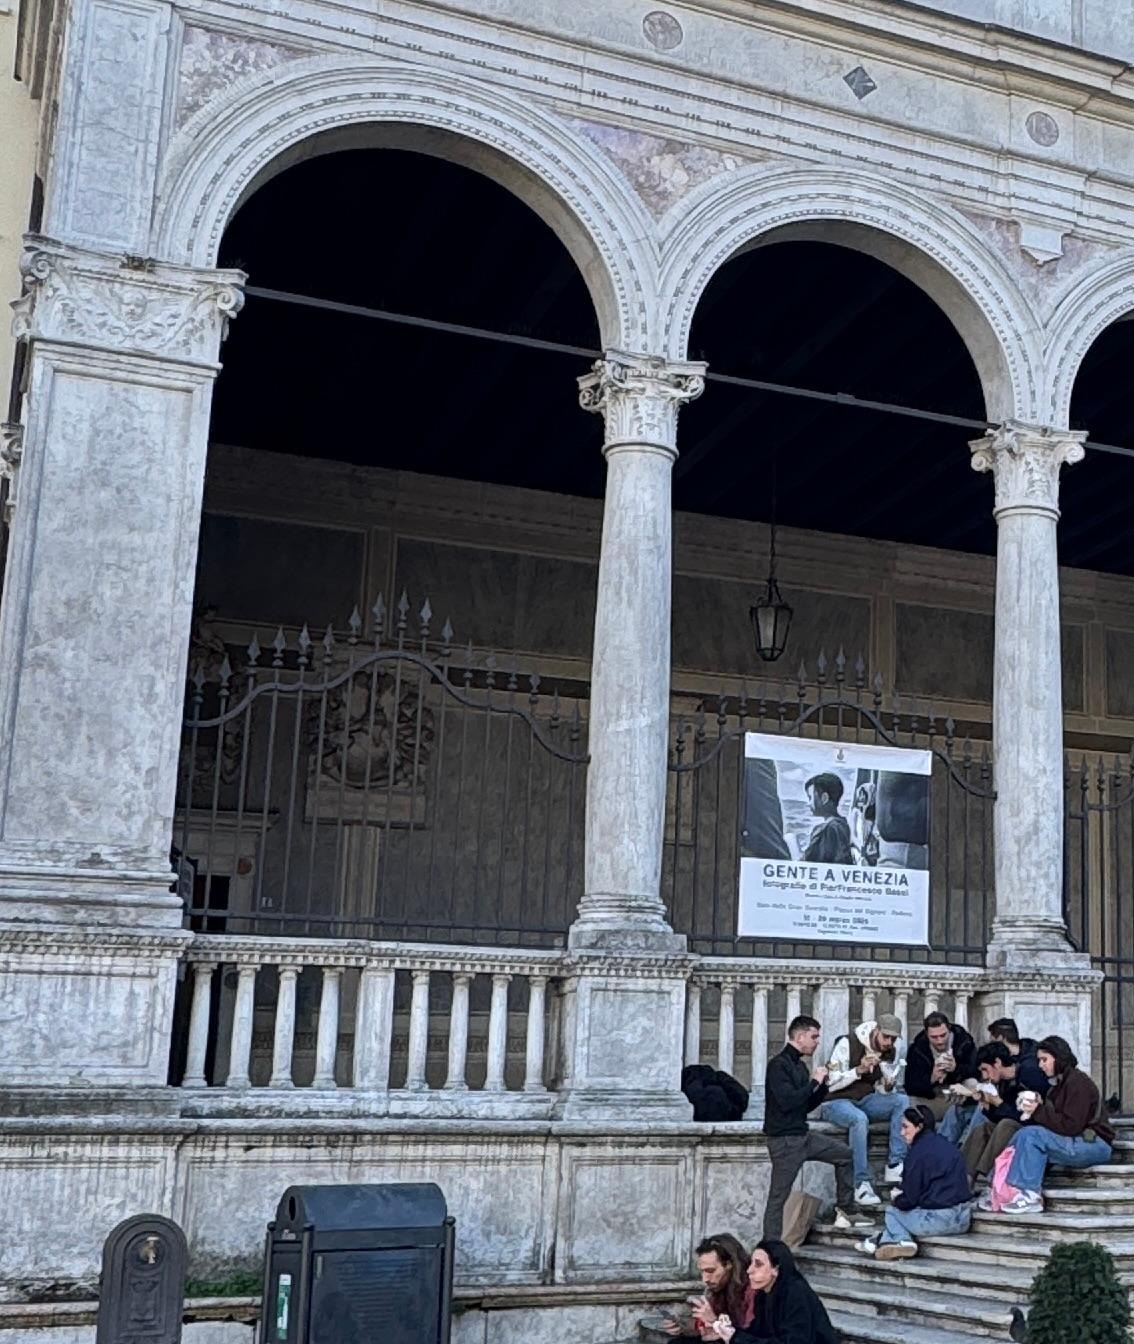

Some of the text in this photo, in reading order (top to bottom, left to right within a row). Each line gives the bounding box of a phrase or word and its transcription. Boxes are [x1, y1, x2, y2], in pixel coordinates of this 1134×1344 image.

[763, 863, 909, 887] GENTE A VENEZIA
